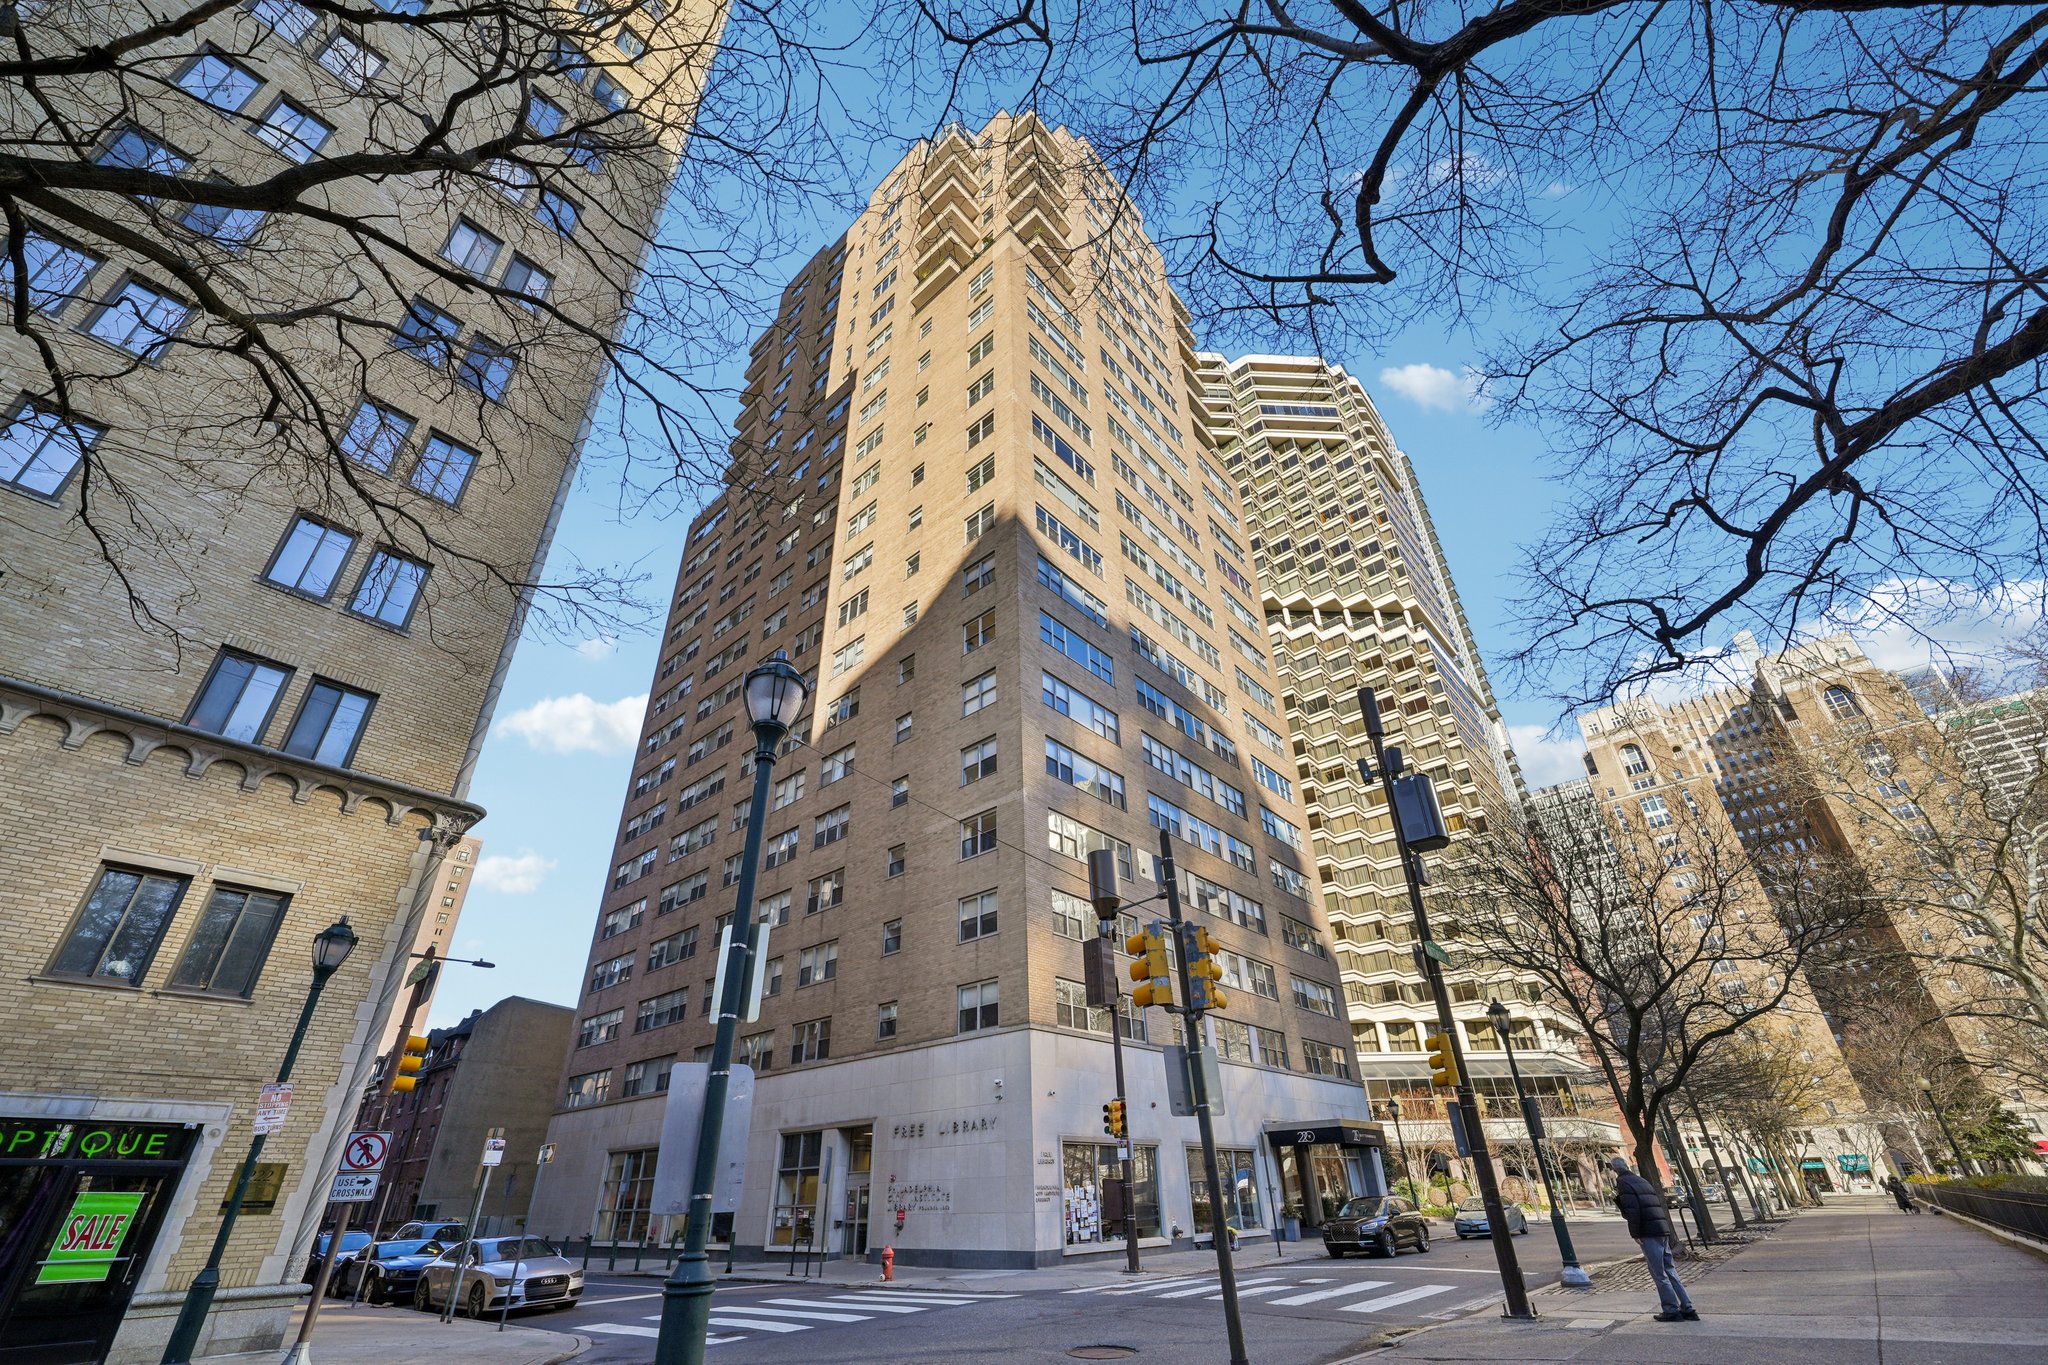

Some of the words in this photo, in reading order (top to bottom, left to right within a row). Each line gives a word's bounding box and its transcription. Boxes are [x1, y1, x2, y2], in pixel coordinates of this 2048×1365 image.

[271, 1094, 282, 1102] NO
[893, 1123, 925, 1139] FREE
[938, 1117, 998, 1135] LIBRARY
[0, 1130, 169, 1158] PTIQUE
[338, 1178, 356, 1187] USE
[331, 1188, 374, 1198] CROSSWALK
[59, 1214, 128, 1251] SALE
